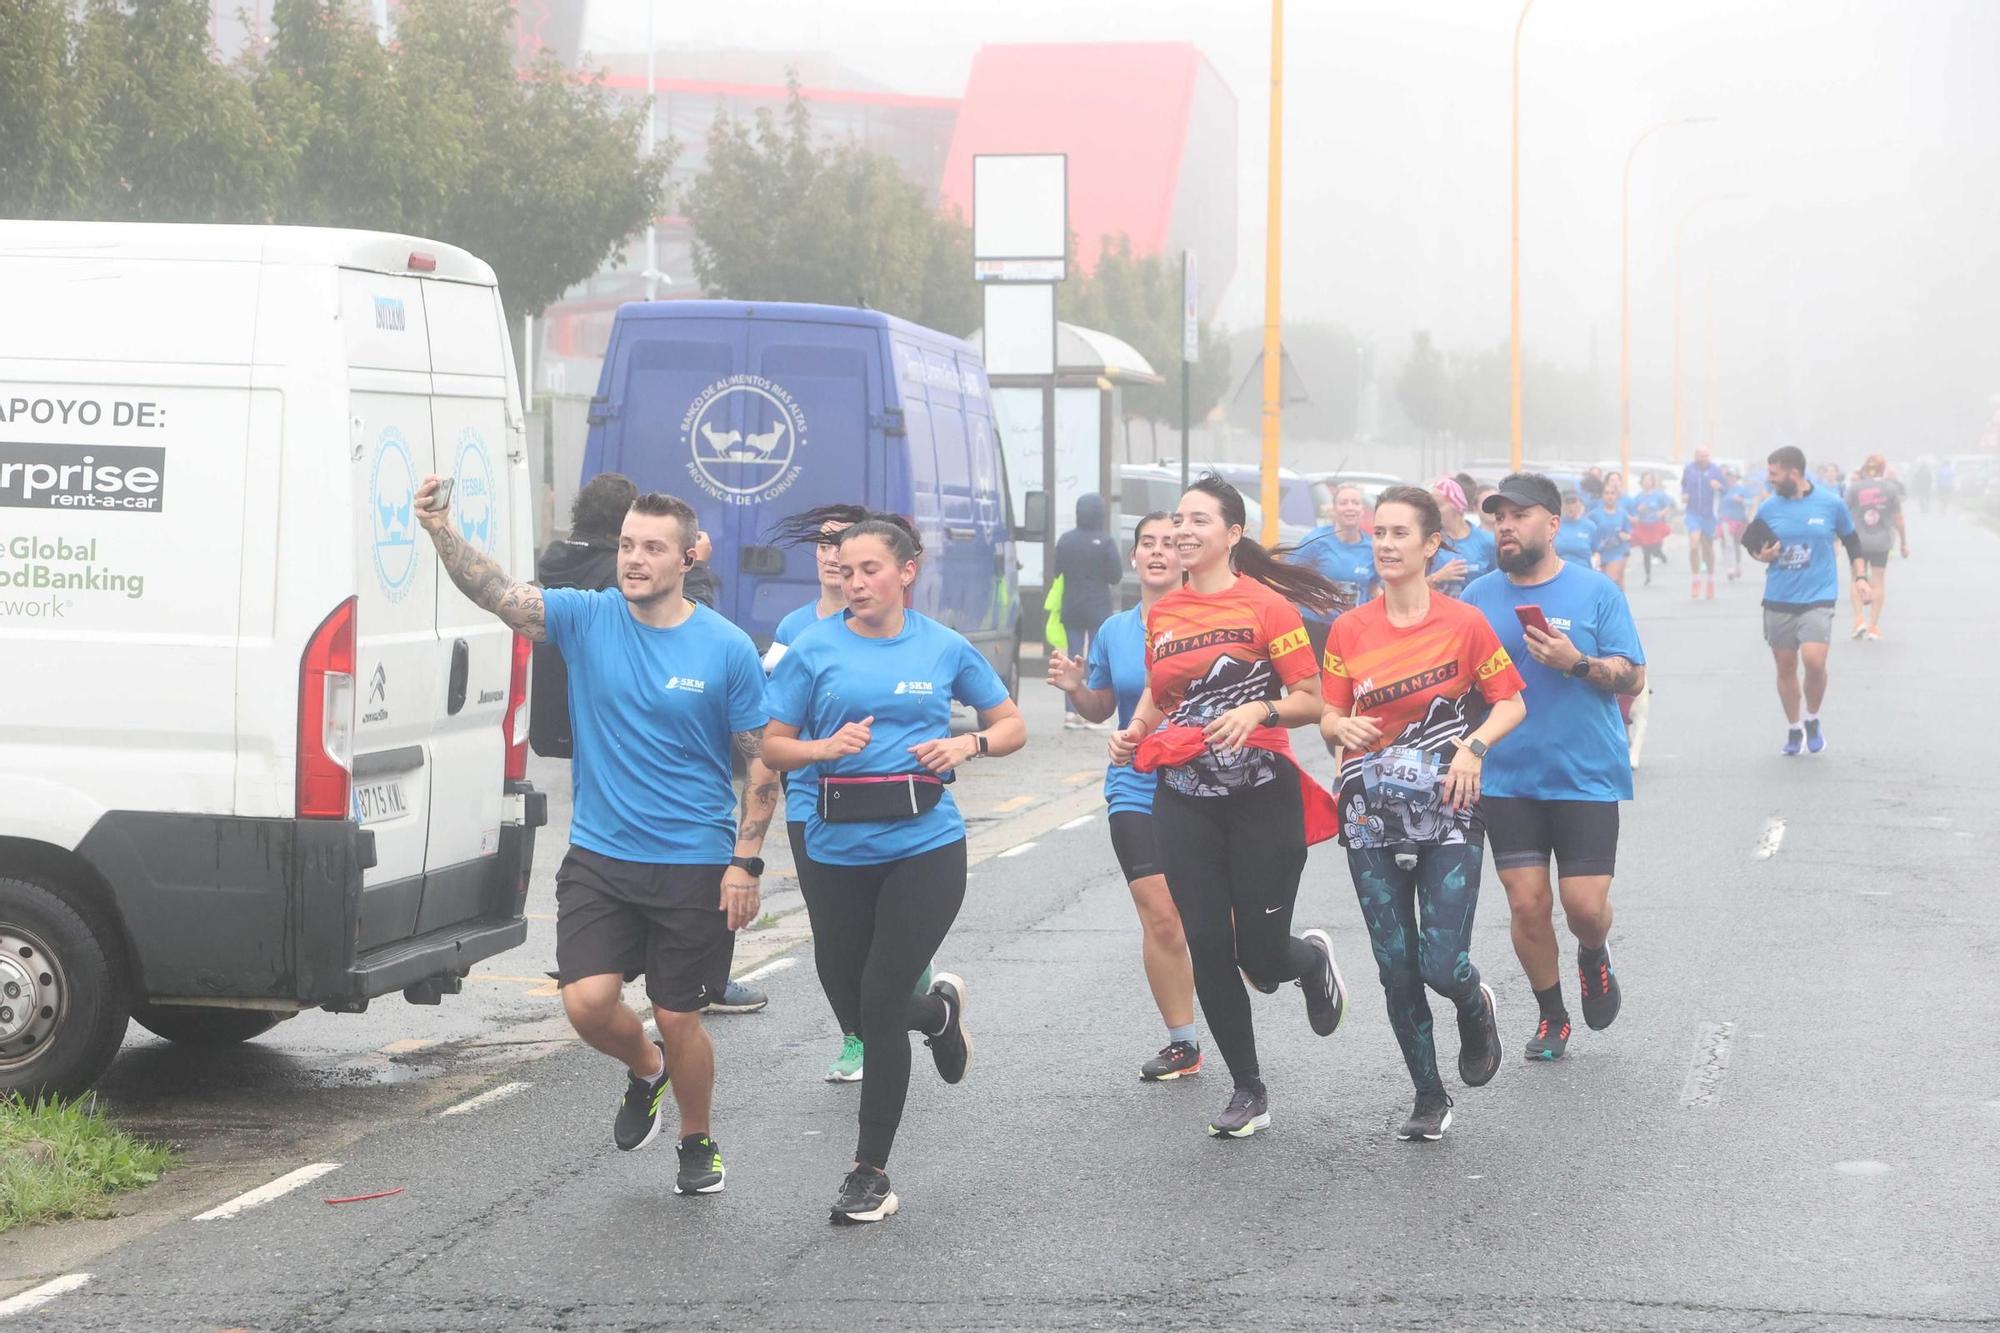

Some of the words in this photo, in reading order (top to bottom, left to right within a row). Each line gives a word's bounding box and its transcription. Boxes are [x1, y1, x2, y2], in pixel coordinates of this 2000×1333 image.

[113, 401, 166, 428] DE:
[680, 396, 705, 432] BANCO
[702, 384, 717, 400] DE
[716, 373, 772, 389] ALIMENTOS
[771, 383, 793, 403] RIAS
[789, 403, 808, 433] ALTAS
[50, 493, 158, 509] rent-a-car
[736, 494, 752, 505] DE
[754, 494, 762, 503] A
[9, 535, 97, 561] Global
[0, 593, 64, 618] work
[359, 786, 387, 818] 8715
[385, 783, 407, 812] KWL
